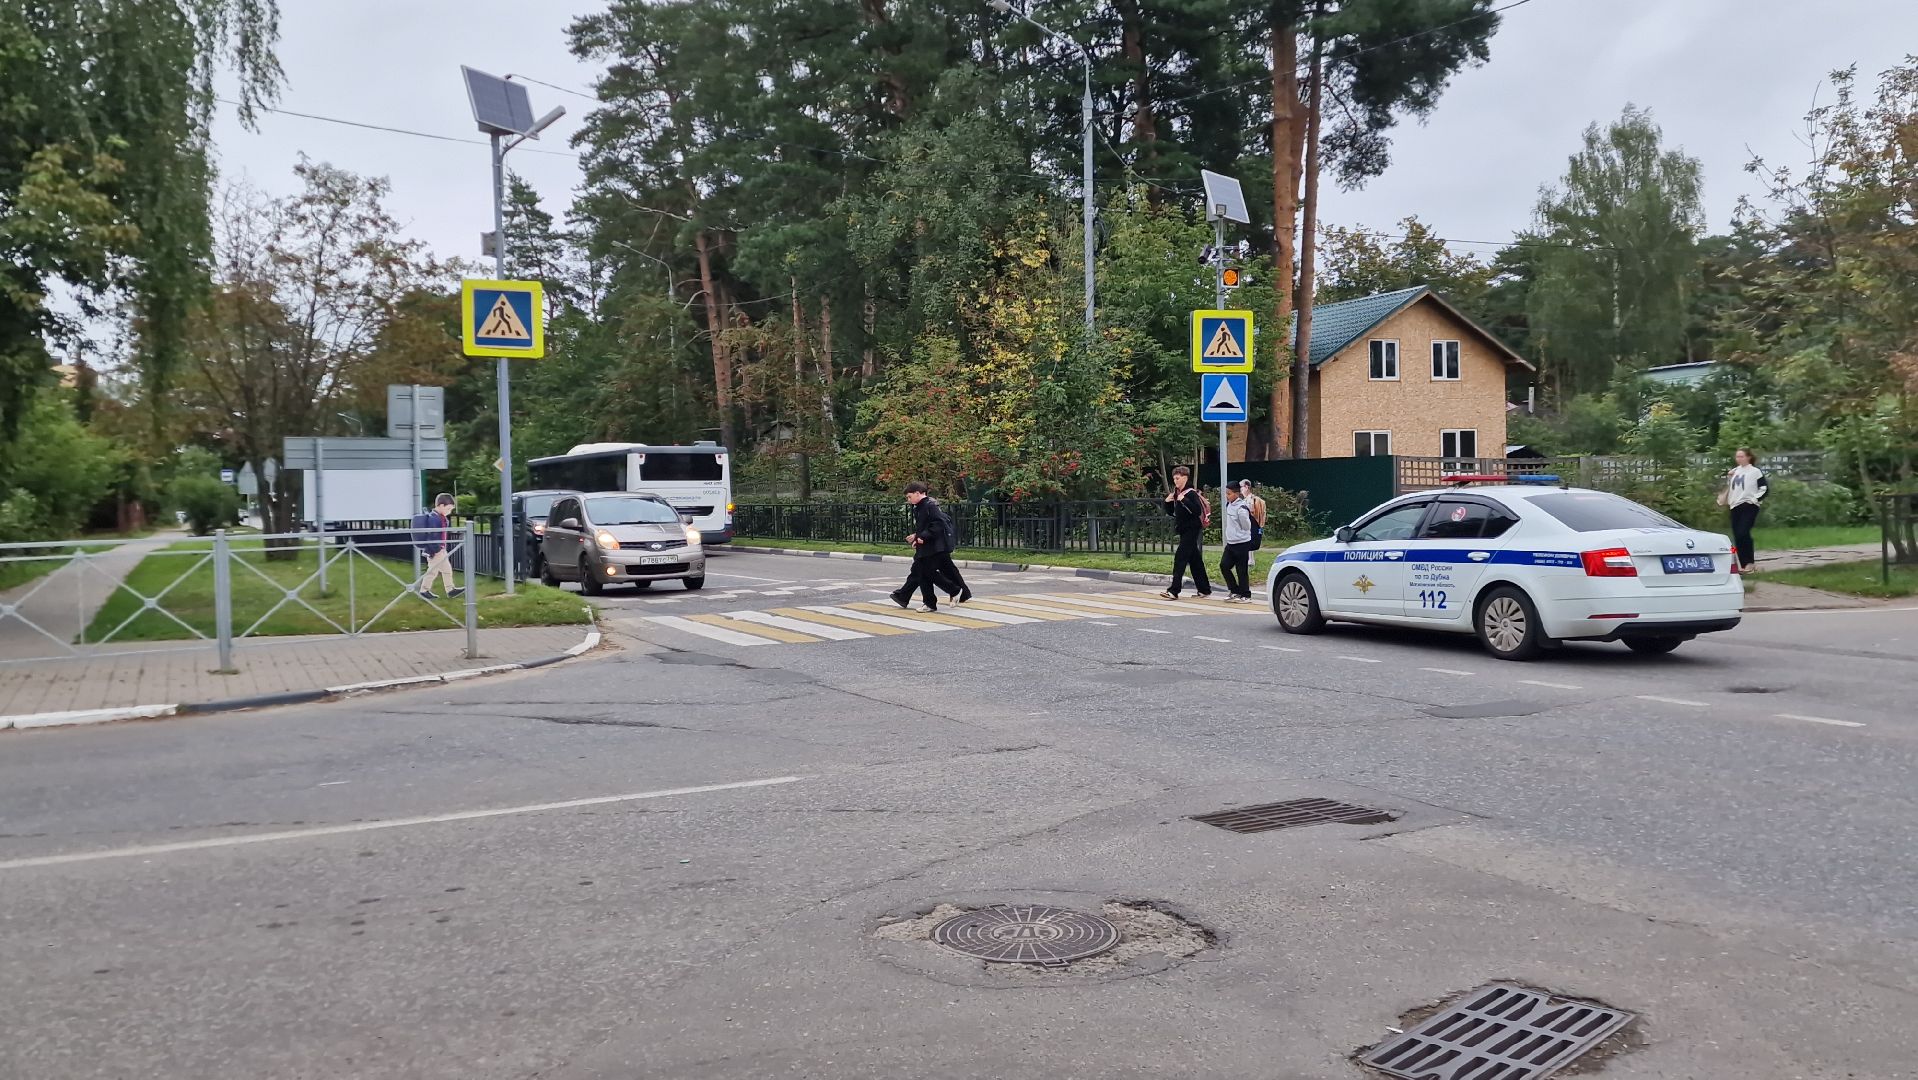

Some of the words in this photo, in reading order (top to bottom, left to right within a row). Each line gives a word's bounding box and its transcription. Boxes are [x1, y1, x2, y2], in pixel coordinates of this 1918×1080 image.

[1343, 551, 1384, 561] ПОЛИЦИЯ
[1675, 557, 1698, 569] 5140
[1430, 573, 1450, 581] Дубна
[1419, 590, 1447, 609] 112
